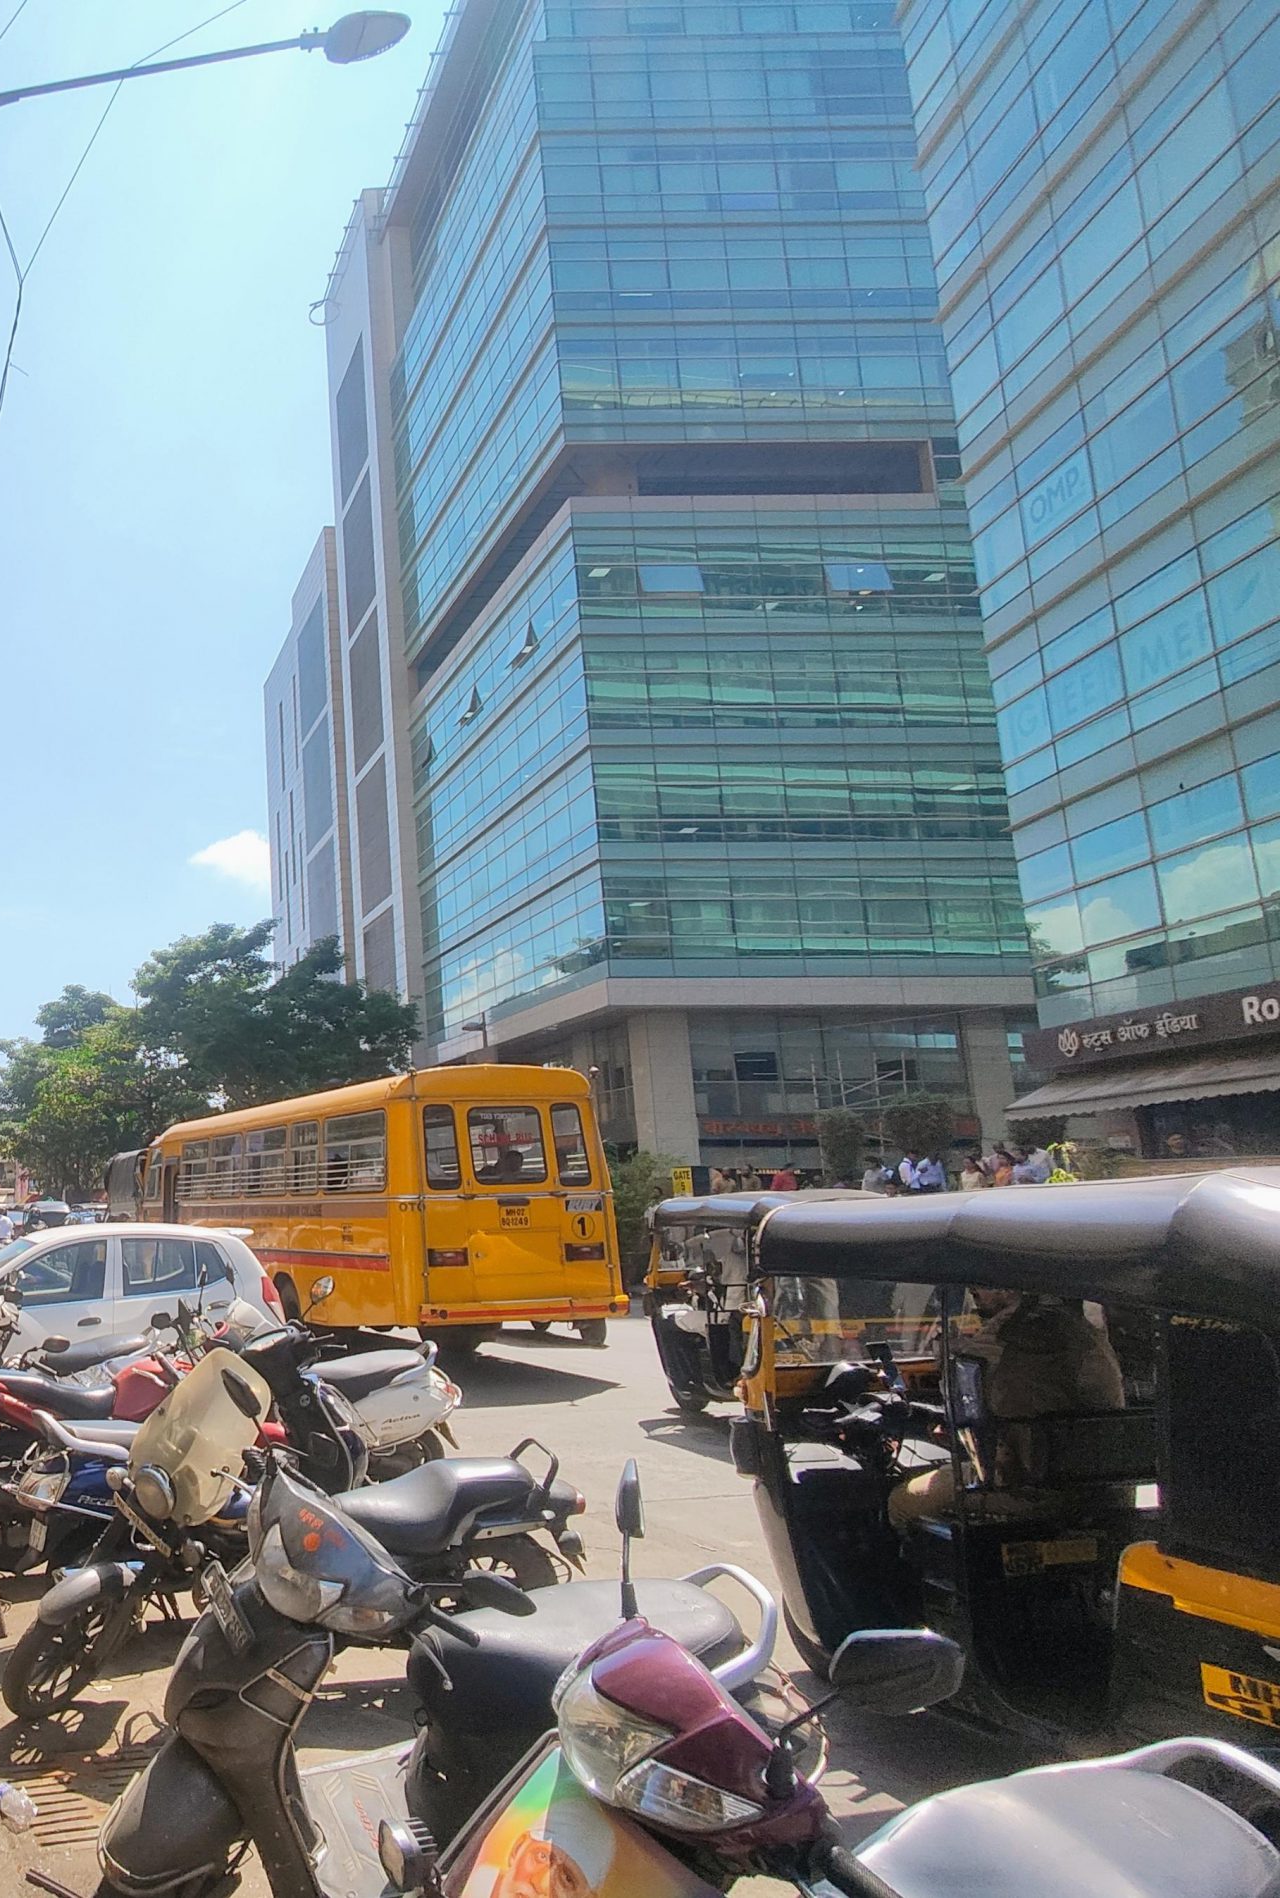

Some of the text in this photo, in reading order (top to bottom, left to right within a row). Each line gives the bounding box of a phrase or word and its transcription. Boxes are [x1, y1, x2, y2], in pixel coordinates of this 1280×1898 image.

[1242, 996, 1280, 1025] Ro
[1154, 1012, 1199, 1038] इंडिया
[673, 1170, 691, 1180] GATE
[577, 1217, 587, 1236] 1
